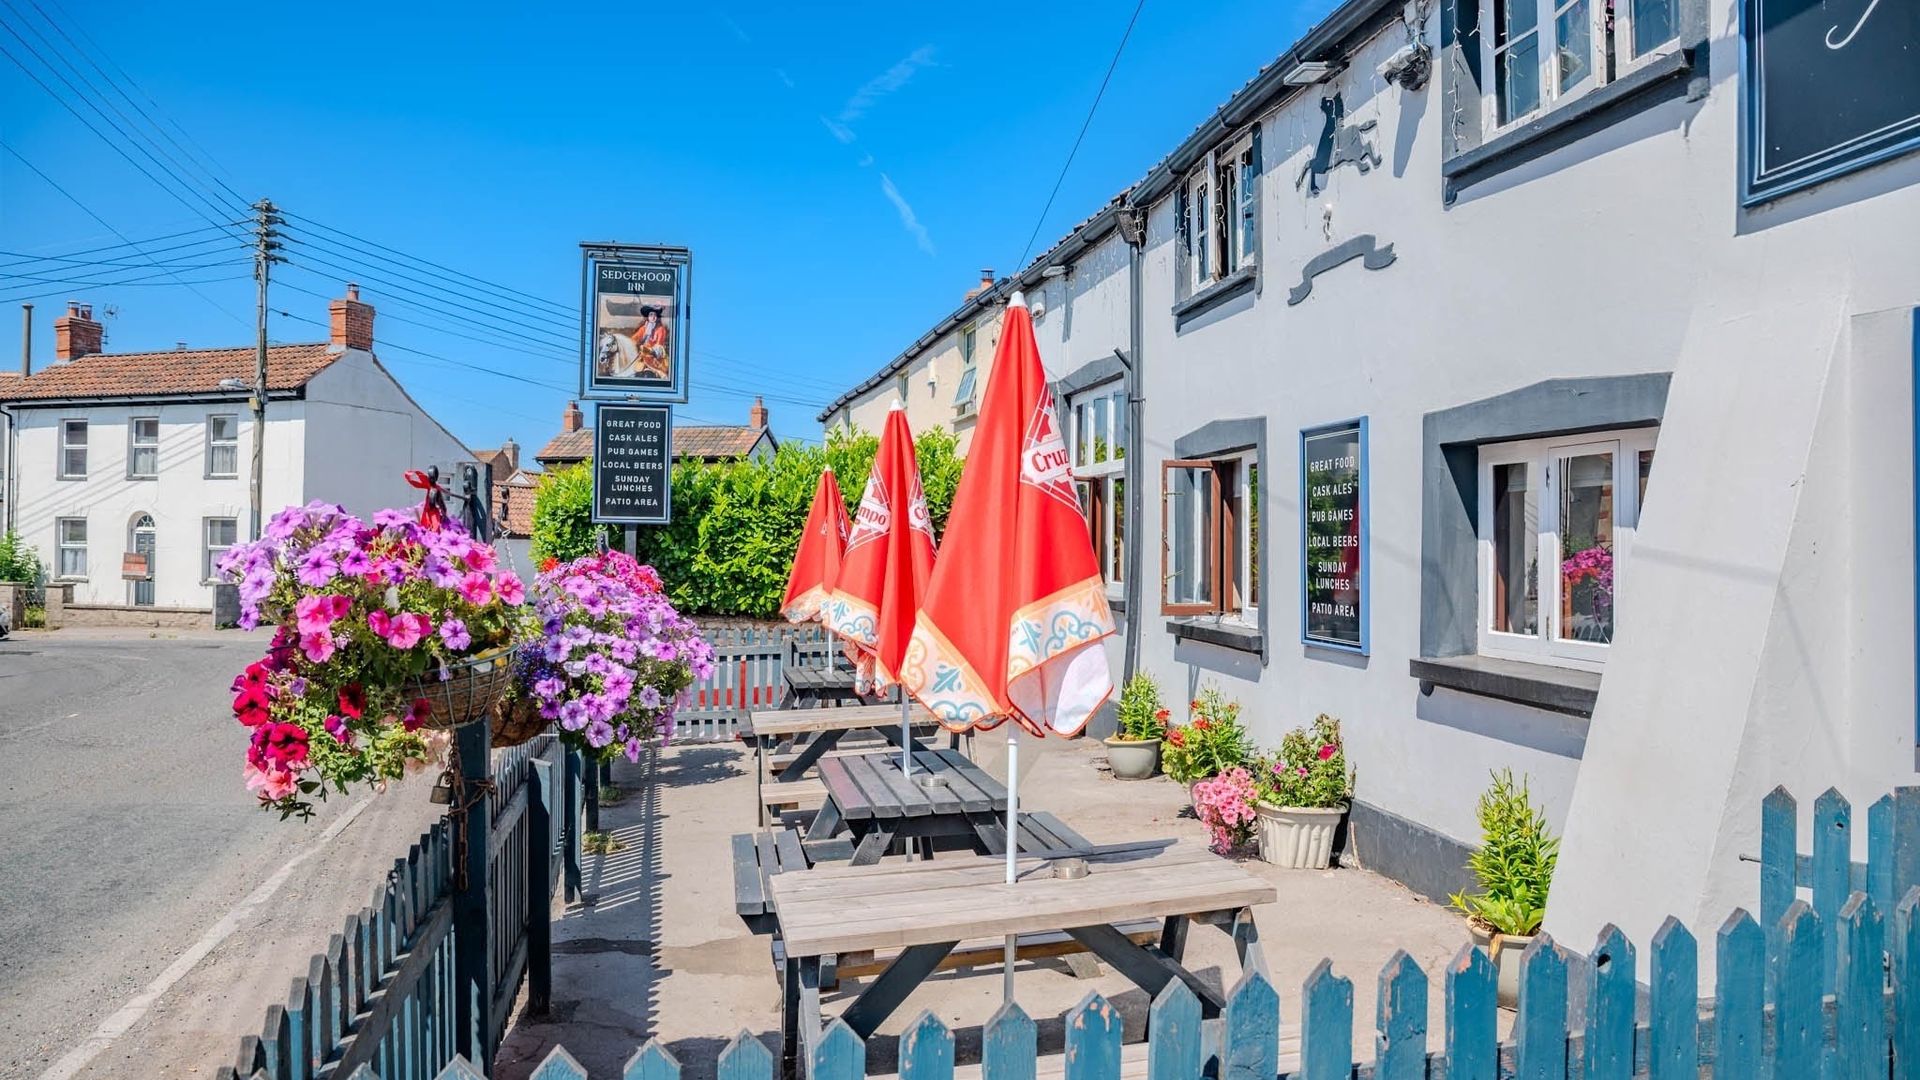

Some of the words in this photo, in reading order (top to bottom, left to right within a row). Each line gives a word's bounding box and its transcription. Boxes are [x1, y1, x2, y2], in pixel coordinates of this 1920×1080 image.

[601, 270, 671, 282] SEDGEMOOR
[627, 282, 645, 292] INN
[606, 420, 635, 428] GREAT
[638, 421, 661, 429] FOOD
[608, 434, 632, 442] CASK
[634, 434, 658, 442] ALES
[607, 447, 625, 455] PUB
[628, 448, 659, 456] GAMES
[602, 461, 631, 469] LOCAL
[633, 462, 663, 470] BEERS
[1310, 459, 1333, 473] GREAT
[1334, 455, 1355, 469] FOOD
[614, 475, 650, 483] SUNDAY
[611, 484, 653, 492] LUNCHES
[1312, 484, 1331, 498] CASK
[1332, 482, 1353, 496] ALES
[605, 497, 631, 505] PATIO
[634, 498, 658, 506] AREA
[1311, 510, 1326, 523] PUB
[1327, 508, 1354, 522] GAMES
[1308, 535, 1331, 548] LOCAL
[1332, 535, 1359, 548] BEERS
[1318, 561, 1347, 574] SUNDAY
[1315, 577, 1350, 591] LUNCHES
[1311, 602, 1333, 616] PATIO
[1334, 604, 1356, 618] AREA
